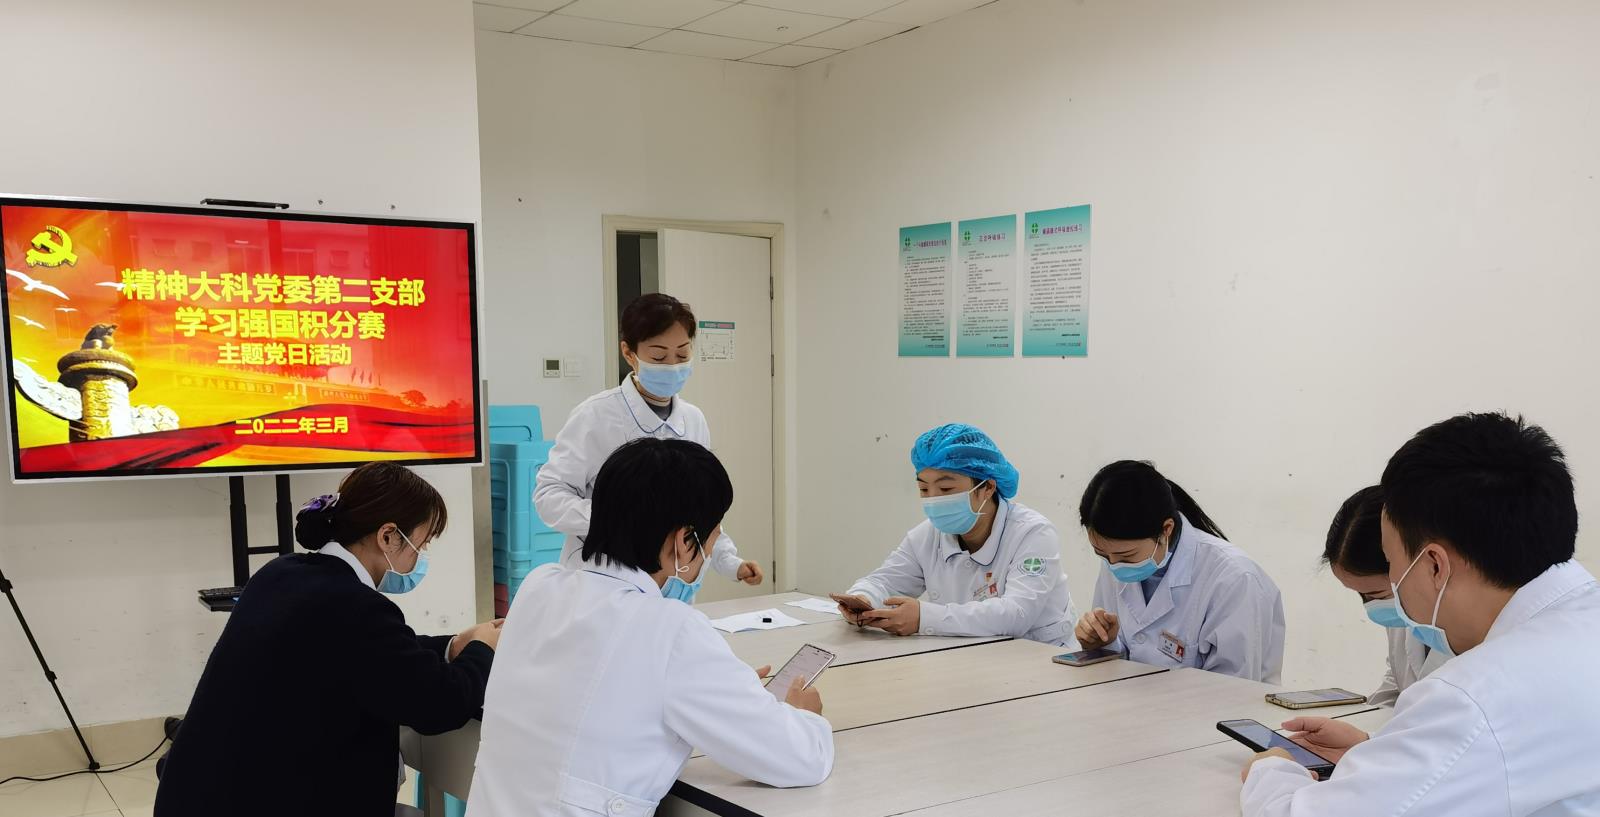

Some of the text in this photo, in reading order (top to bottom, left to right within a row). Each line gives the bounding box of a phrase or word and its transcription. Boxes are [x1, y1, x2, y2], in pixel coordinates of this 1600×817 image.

[121, 268, 426, 306] 精神大科党委第二支部
[175, 306, 385, 340] 学习强国积分赛
[217, 343, 352, 365] 主题党日活动
